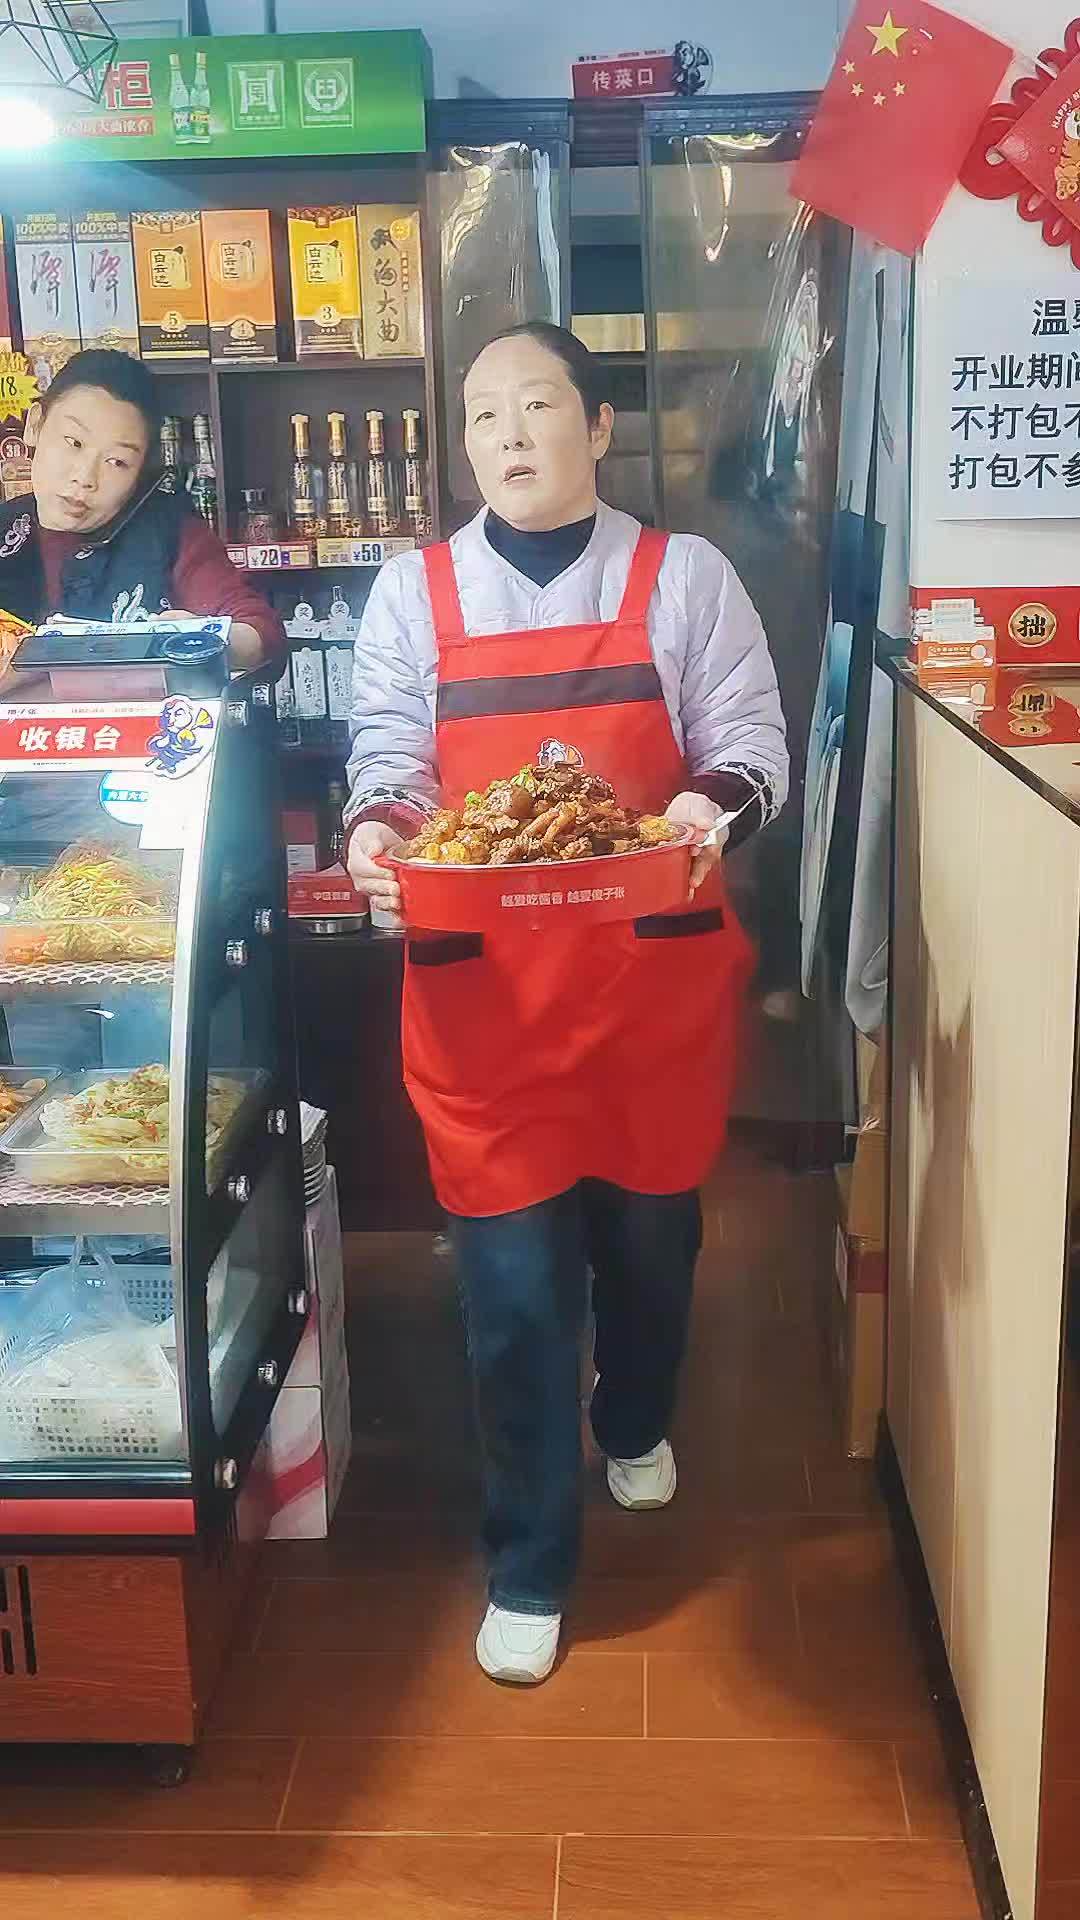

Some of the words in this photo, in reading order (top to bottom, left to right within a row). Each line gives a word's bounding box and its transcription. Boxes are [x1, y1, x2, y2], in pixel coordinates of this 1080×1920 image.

[592, 68, 653, 91] 传菜口
[1051, 97, 1072, 128] HAPPY
[168, 313, 178, 326] 5
[322, 307, 333, 321] 3
[1032, 299, 1080, 336] 温
[19, 724, 121, 752] 收银台
